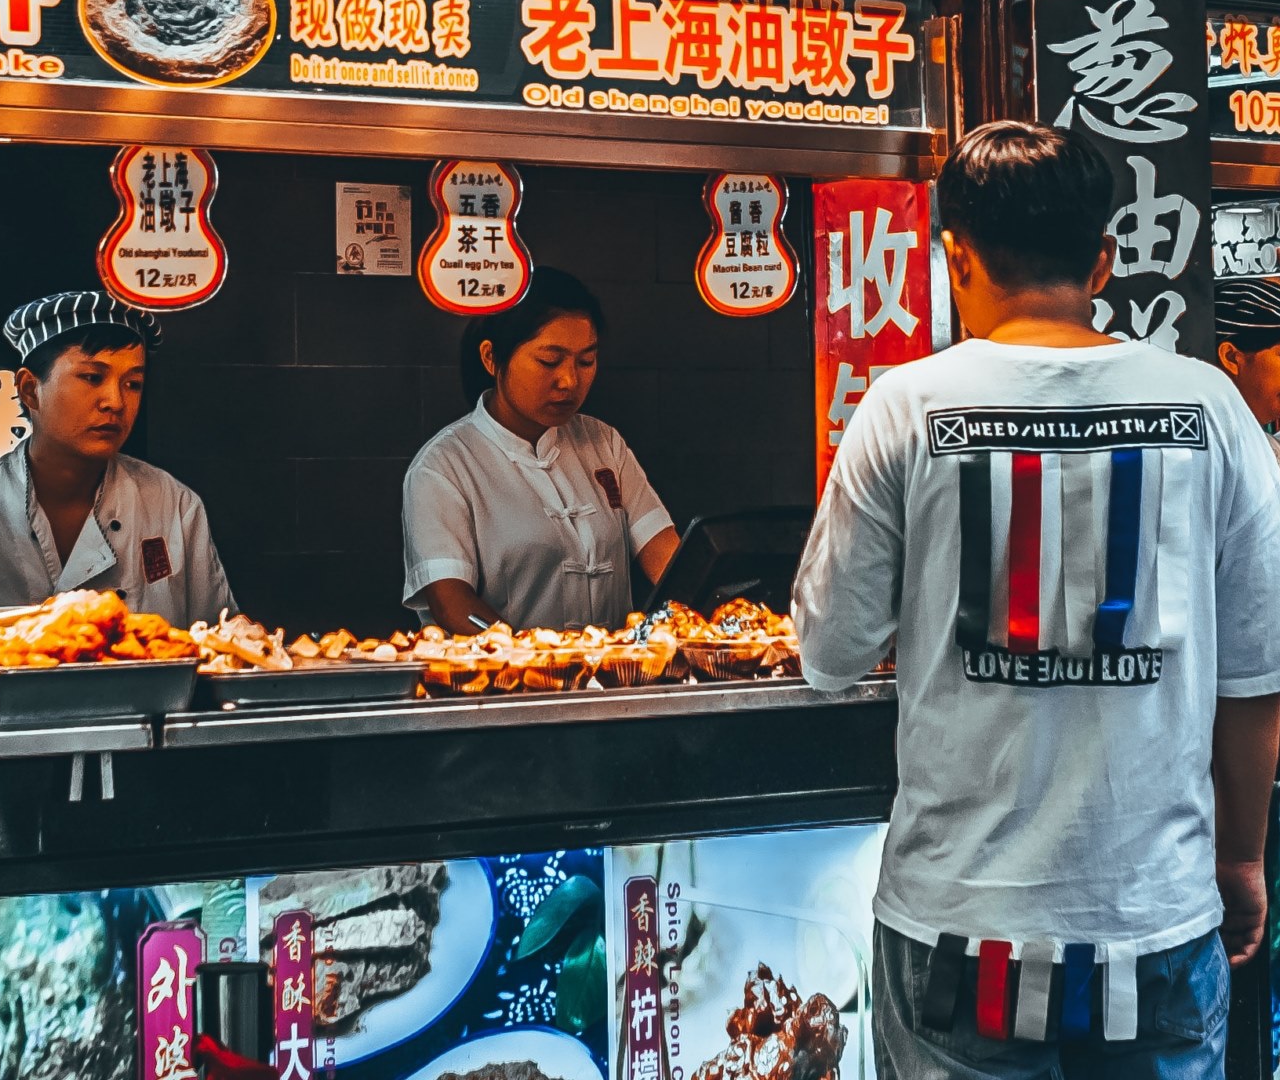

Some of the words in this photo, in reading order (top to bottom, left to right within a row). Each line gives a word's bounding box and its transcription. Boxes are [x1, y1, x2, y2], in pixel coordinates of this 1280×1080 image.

[291, 59, 309, 77] Do
[311, 60, 322, 78] it
[324, 62, 337, 79] at
[340, 66, 369, 81] once
[371, 65, 394, 83] and
[396, 66, 420, 84] sell
[421, 67, 431, 84] it
[433, 69, 446, 85] at
[447, 72, 476, 88] once
[525, 85, 581, 107] Old
[590, 91, 740, 118] shanghai
[746, 99, 890, 125] youdunzi
[142, 152, 188, 189] 老上海
[458, 194, 501, 219] 五香
[457, 224, 504, 254] 茶干
[725, 230, 770, 258] 豆腐粒
[118, 247, 134, 258] Old
[439, 258, 464, 269] Quail
[465, 260, 482, 271] egg
[483, 259, 499, 271] Dry
[499, 259, 515, 270] tea
[135, 268, 197, 288] 12元/2只
[712, 263, 741, 274] Maotai
[742, 262, 763, 272] Bean
[764, 261, 782, 272] curd
[457, 278, 506, 297] 12元/客
[729, 281, 774, 299] 12元/客
[963, 650, 1031, 682] LOVE
[1101, 652, 1163, 682] LOVE
[669, 965, 681, 1058] Lemon
